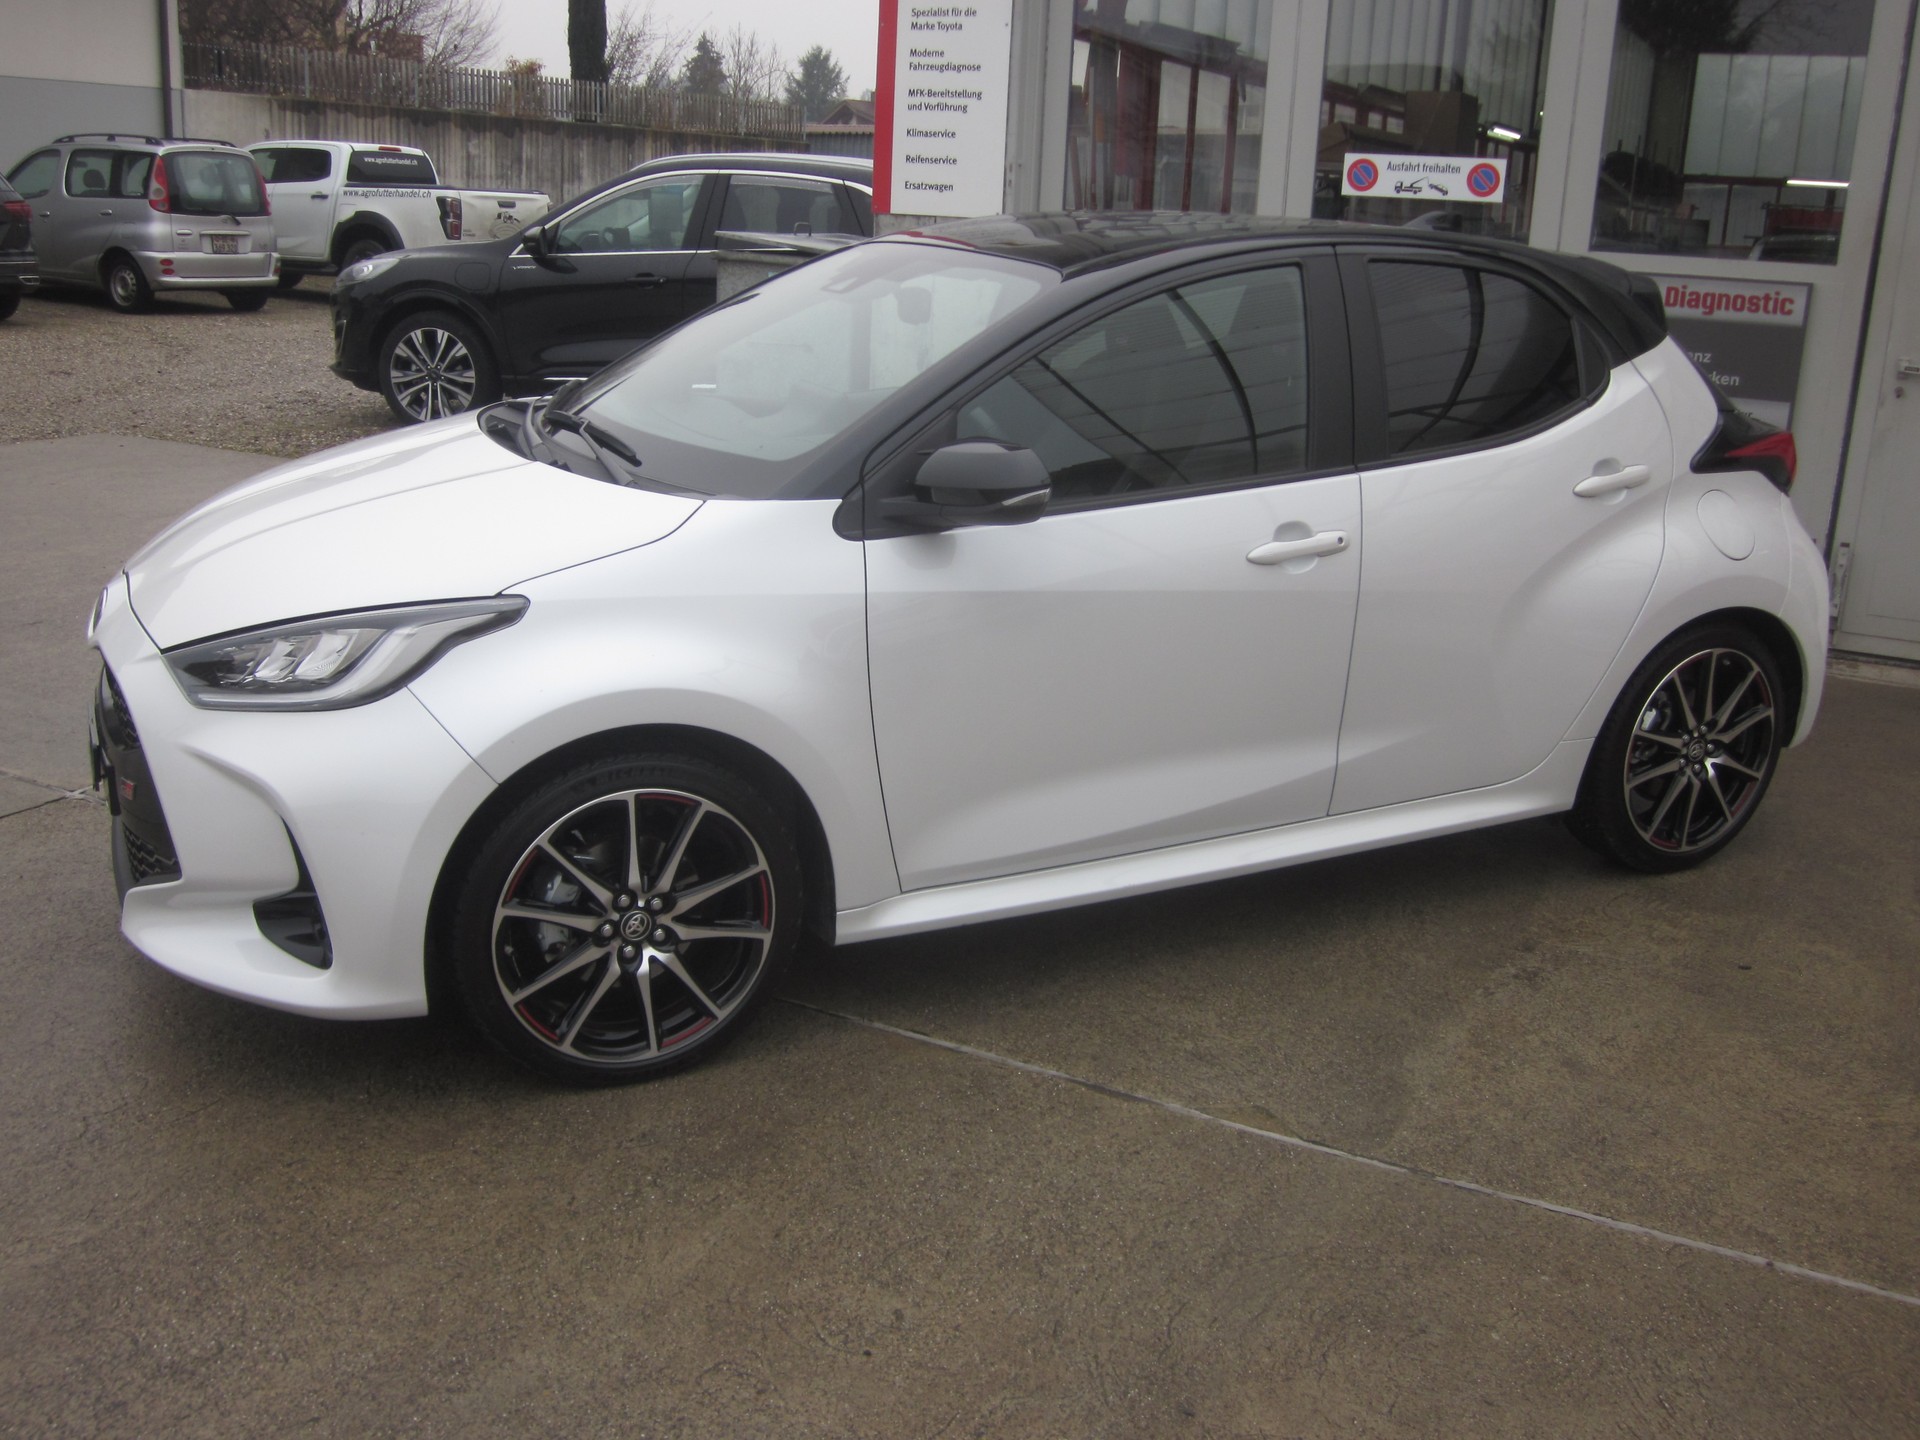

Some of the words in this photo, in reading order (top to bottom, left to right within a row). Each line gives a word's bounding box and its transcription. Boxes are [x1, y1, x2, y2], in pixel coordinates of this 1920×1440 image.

[911, 7, 950, 18] Spezialist
[951, 8, 963, 17] für
[964, 8, 977, 17] die
[911, 21, 936, 31] Marke
[937, 21, 963, 33] Toyota
[909, 48, 945, 58] Moderne
[909, 62, 981, 73] Fahrzeugdiagnose
[908, 88, 983, 101] MFK-Bereitstellung
[907, 102, 922, 111] und
[924, 102, 968, 114] Vorführung
[906, 128, 956, 139] Klimaservice
[905, 155, 958, 165] Reifenservice
[1386, 161, 1421, 173] Ausfahrt
[1422, 162, 1461, 174] freihalten
[904, 181, 954, 192] Ersatzwagen
[342, 188, 432, 199] www.agrofutterhandel.ch
[1664, 284, 1796, 317] Diagnostic
